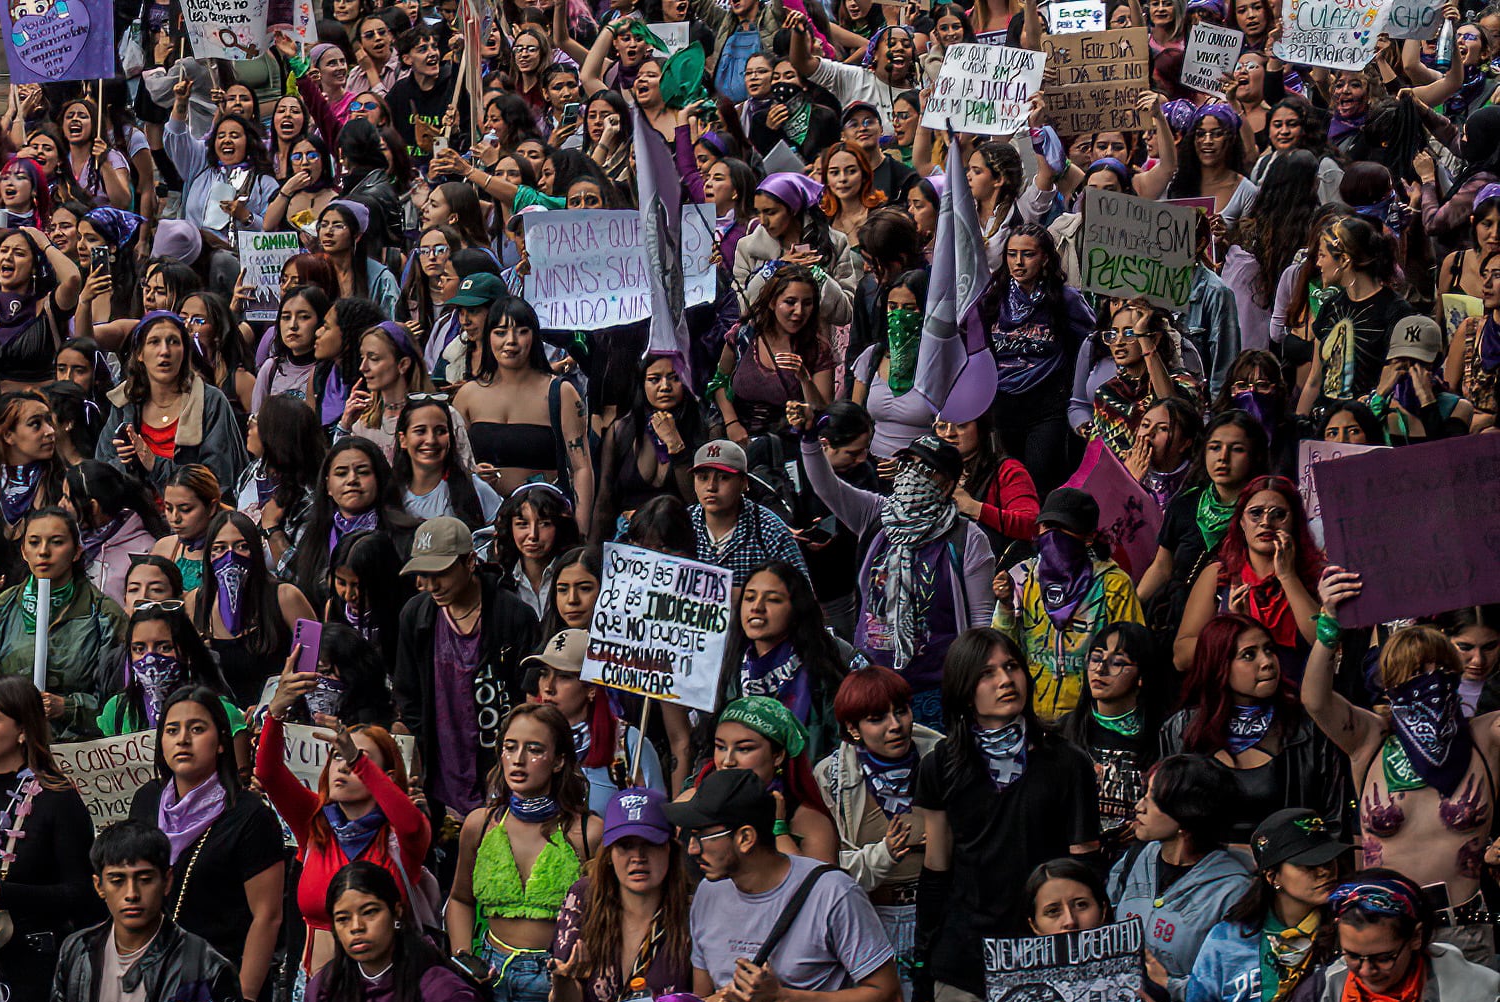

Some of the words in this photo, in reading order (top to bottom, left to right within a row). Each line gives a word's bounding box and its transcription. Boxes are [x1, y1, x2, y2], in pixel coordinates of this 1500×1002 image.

[547, 221, 601, 256] PARA
[607, 216, 645, 249] QUE
[599, 578, 620, 610] de
[675, 567, 728, 603] NIETAS
[625, 617, 646, 642] NO
[983, 935, 1057, 972] SIEMBRA
[1066, 917, 1143, 965] LIBERTAD
